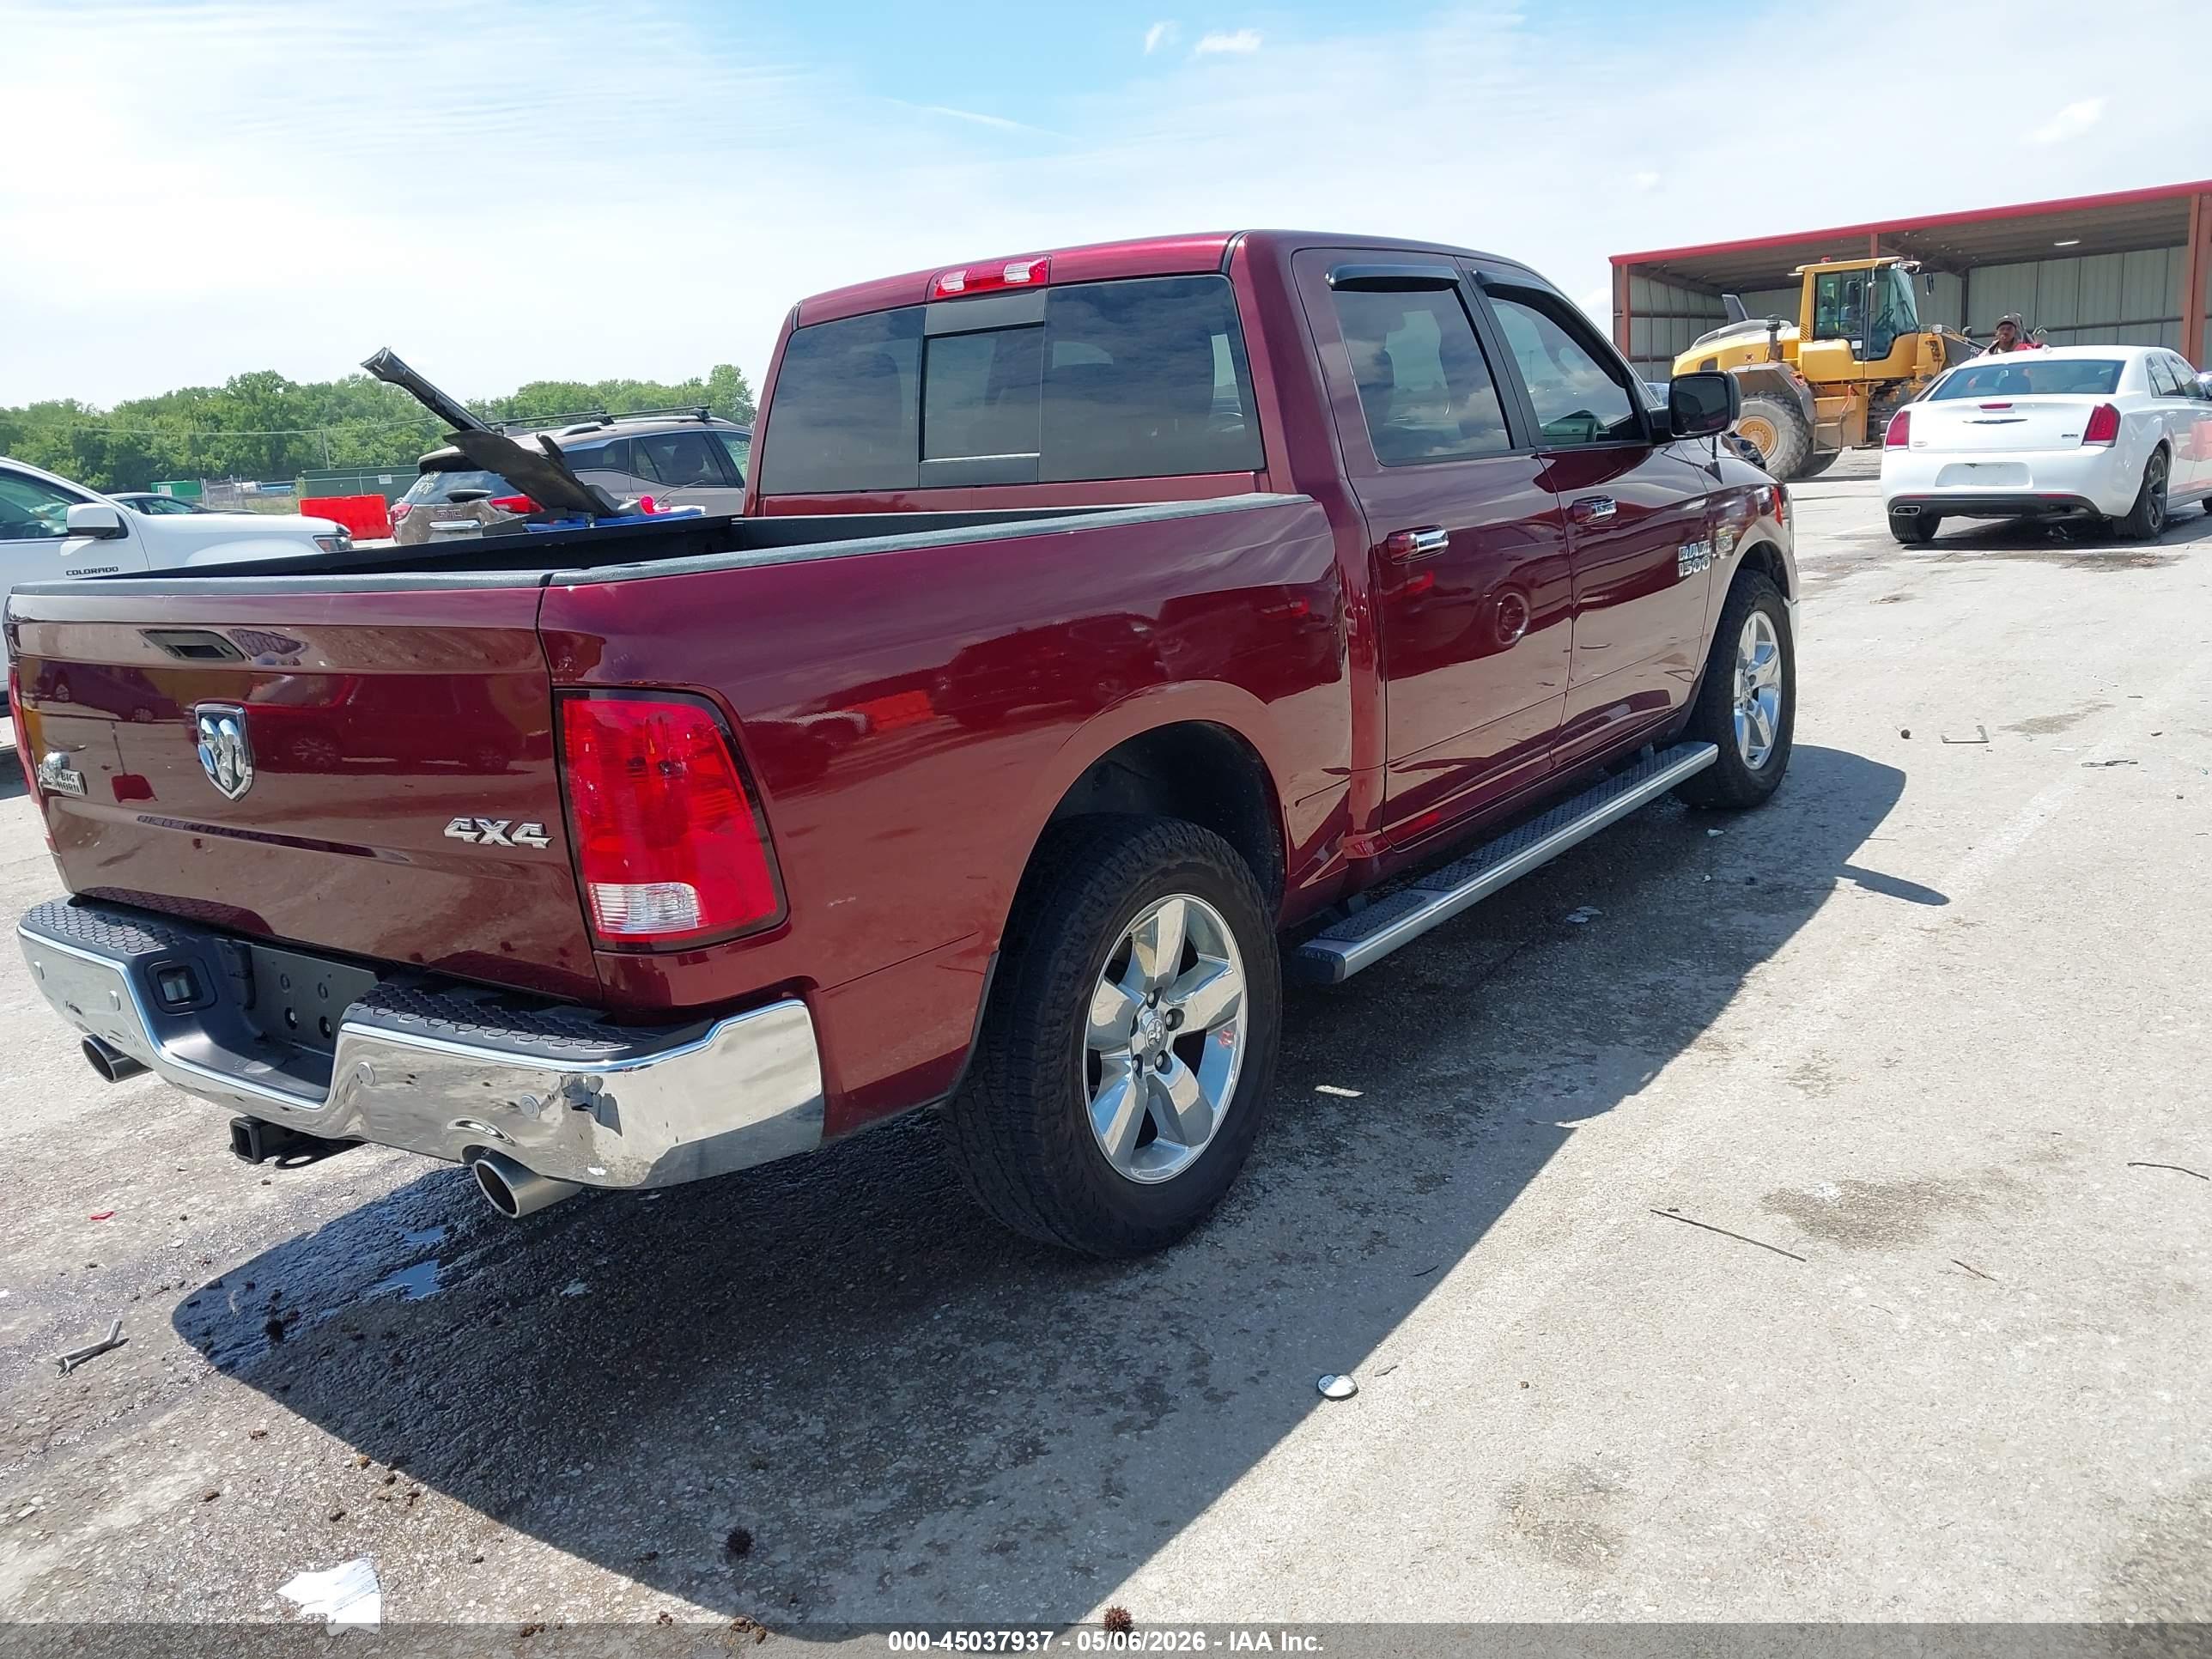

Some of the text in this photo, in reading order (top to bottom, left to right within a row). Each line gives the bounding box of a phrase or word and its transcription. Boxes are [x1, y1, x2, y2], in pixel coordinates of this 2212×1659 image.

[1678, 539, 1711, 562] RAM
[66, 566, 119, 576] COLORADO
[1679, 556, 1711, 578] 1500
[61, 772, 76, 783] BIG
[56, 781, 82, 793] HORN
[443, 817, 555, 849] 4X4
